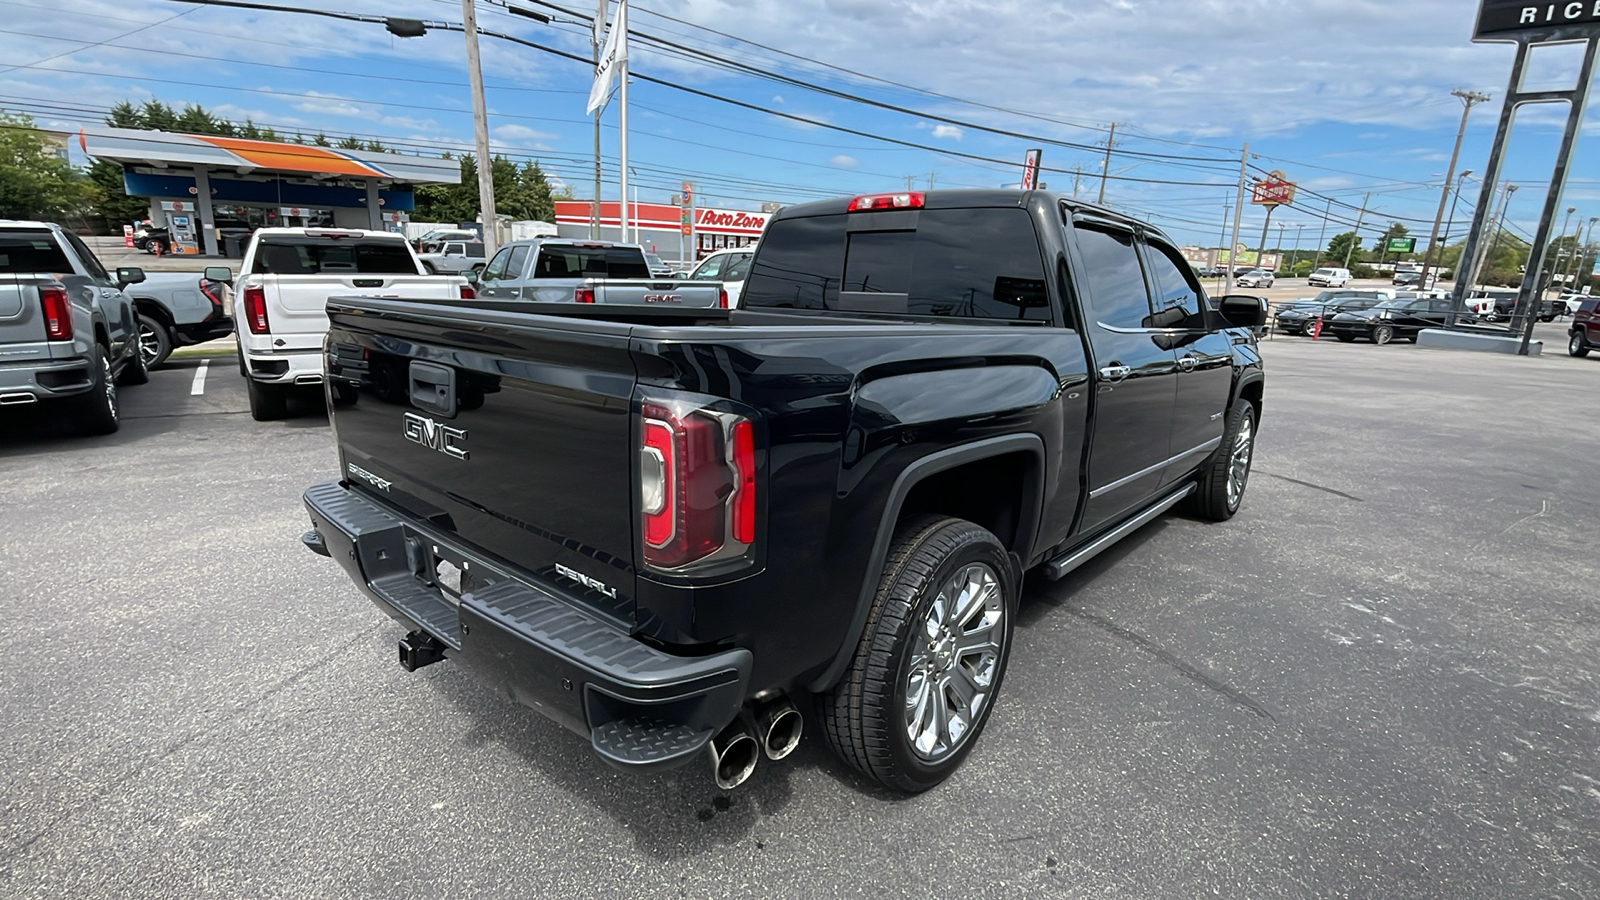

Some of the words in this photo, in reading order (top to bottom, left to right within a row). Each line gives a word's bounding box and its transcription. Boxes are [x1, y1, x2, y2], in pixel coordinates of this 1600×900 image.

[643, 294, 682, 303] GMC
[402, 411, 470, 460] GMC
[348, 462, 393, 493] SIERRA
[555, 562, 617, 599] DENALI
